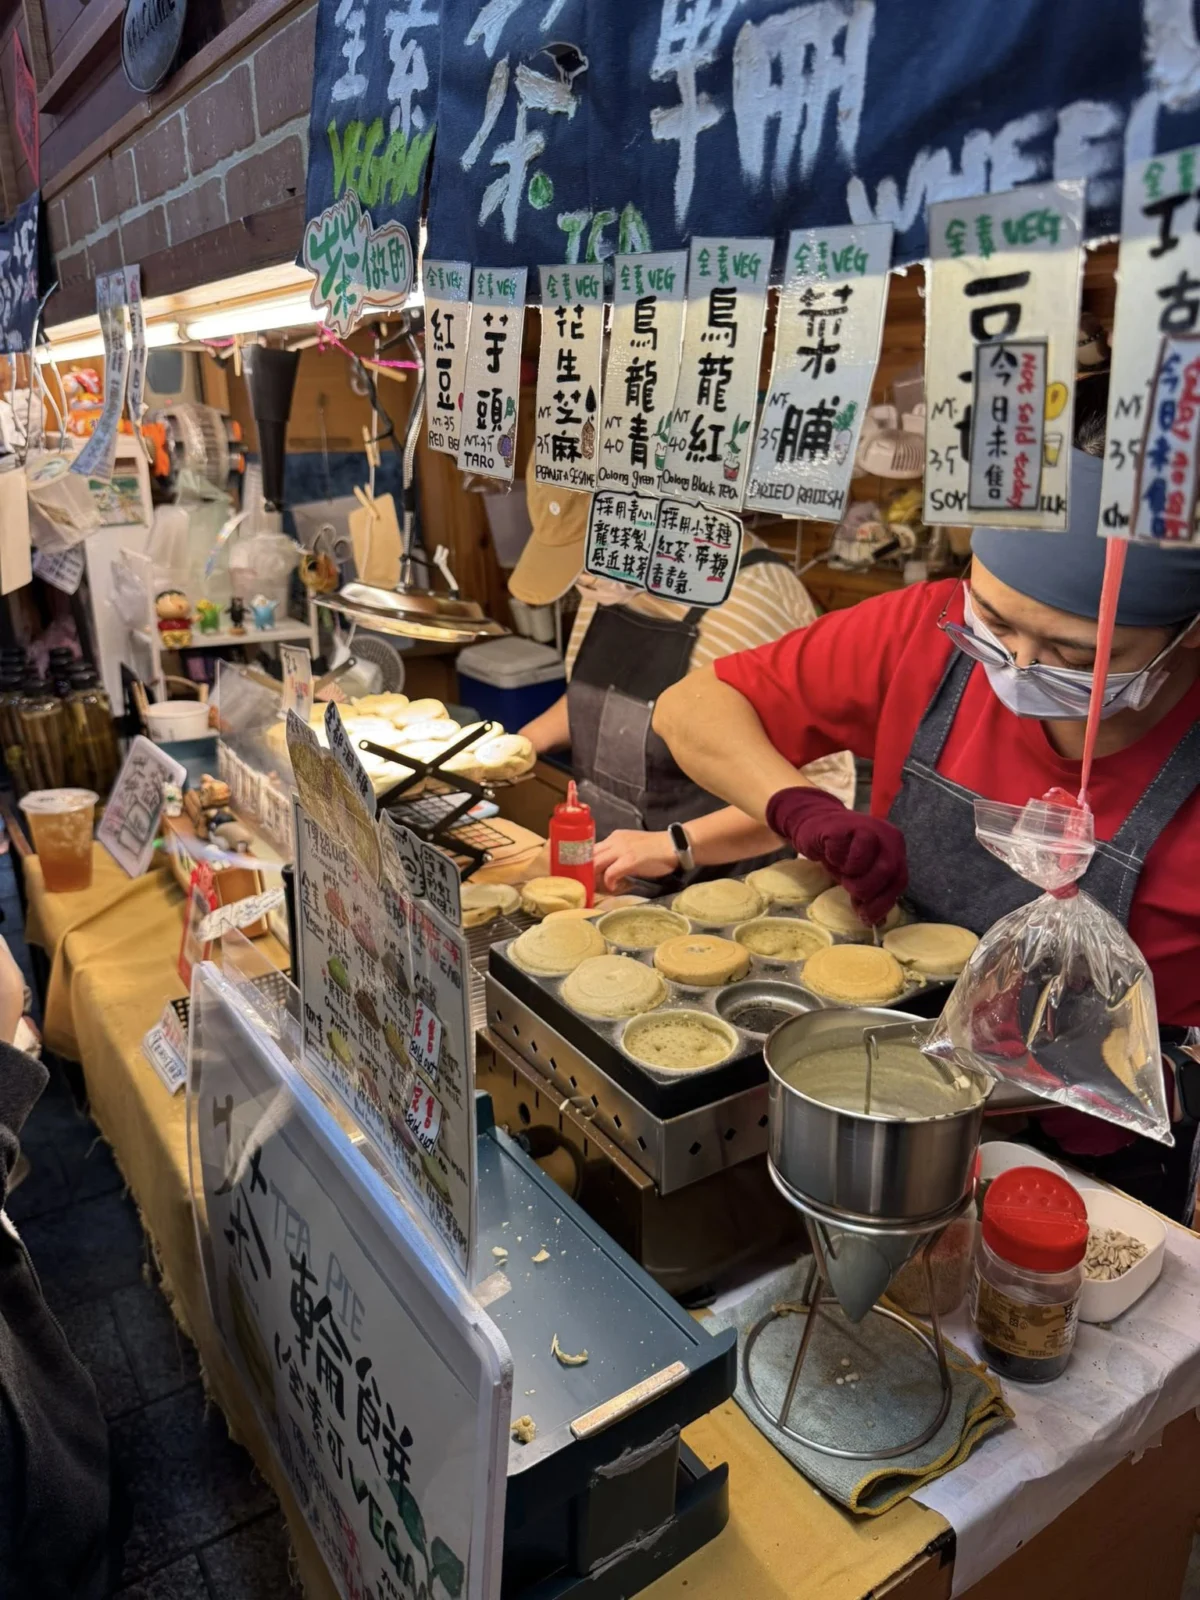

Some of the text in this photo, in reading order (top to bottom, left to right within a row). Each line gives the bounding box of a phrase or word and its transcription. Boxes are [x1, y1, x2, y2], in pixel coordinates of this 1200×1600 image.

[327, 116, 437, 208] VEGAN
[1002, 206, 1062, 246] VEG
[732, 253, 763, 284] VEG
[832, 243, 868, 275] VEG
[575, 274, 601, 299] VEG
[650, 270, 676, 292] VEG
[430, 309, 455, 411] 紅豆
[476, 312, 509, 433] 芋頭
[685, 286, 739, 463] 烏龍紅
[777, 284, 854, 464] 菜脯
[551, 303, 586, 464] 花生芝麻
[625, 296, 658, 470] 烏龍青
[984, 344, 1018, 500] 今日未售
[429, 431, 444, 447] RED
[603, 438, 624, 454] 40
[669, 437, 688, 453] 40
[759, 428, 780, 449] 35
[464, 451, 495, 469] TARO
[929, 445, 959, 476] 35
[598, 467, 629, 486] Oolong
[662, 469, 691, 491] Oolong
[691, 475, 717, 496] Black
[750, 479, 845, 510] DRIED RADISH
[929, 488, 967, 512] SOY
[270, 1179, 367, 1344] TEA PIE
